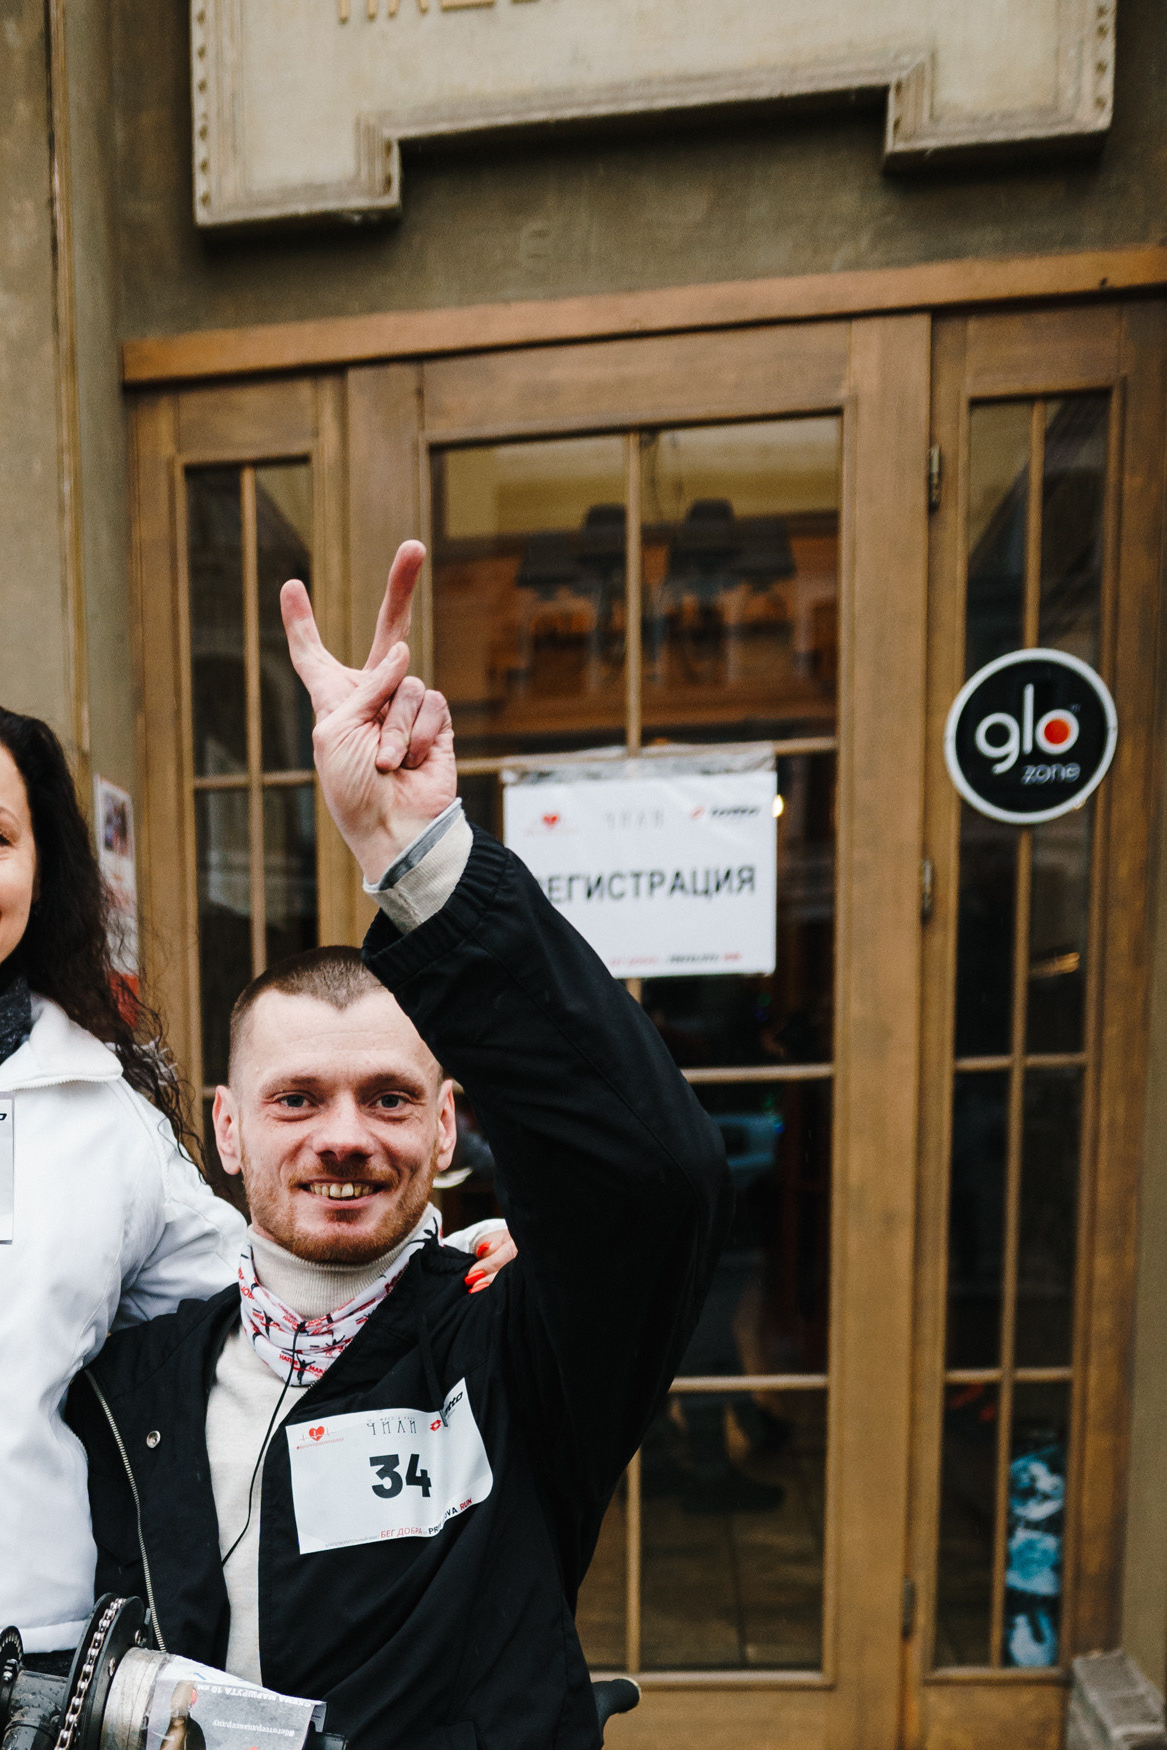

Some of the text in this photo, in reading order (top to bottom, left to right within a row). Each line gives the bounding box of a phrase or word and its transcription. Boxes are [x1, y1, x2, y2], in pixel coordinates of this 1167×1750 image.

[975, 683, 1080, 775] glo
[1021, 762, 1081, 785] zone
[366, 1419, 417, 1437] ЧИЛИ
[368, 1453, 432, 1499] 34
[380, 1528, 395, 1539] БЕГ
[397, 1526, 423, 1537] ДОБРА
[459, 1497, 472, 1510] RUN
[210, 1686, 222, 1695] 10
[225, 1687, 277, 1701] МАРШРУТА
